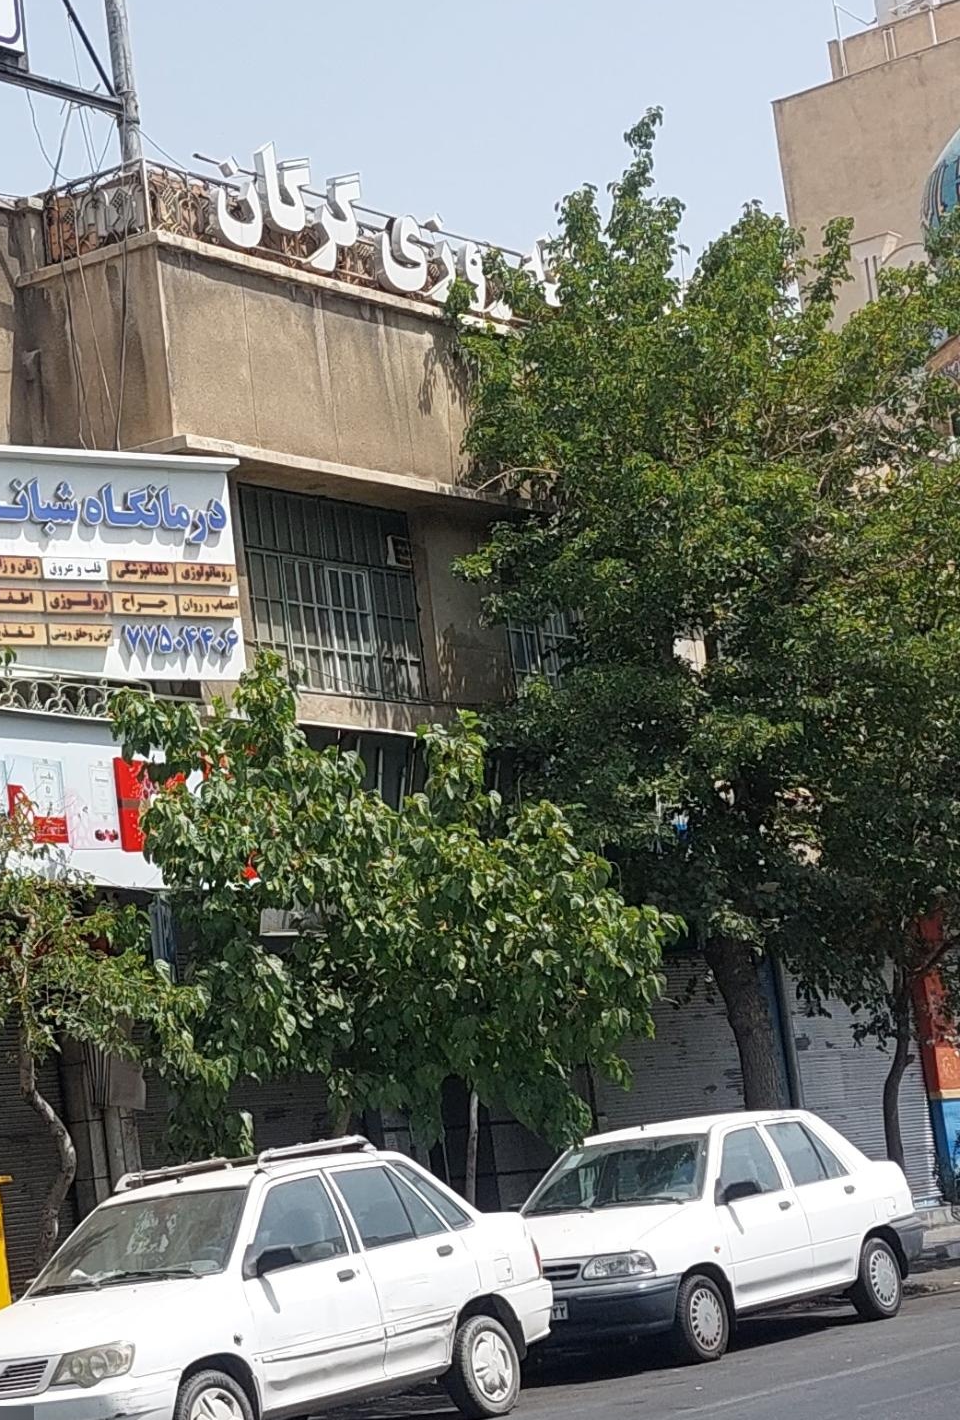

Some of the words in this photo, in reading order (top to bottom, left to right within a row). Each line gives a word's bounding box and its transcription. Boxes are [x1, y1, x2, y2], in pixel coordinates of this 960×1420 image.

[209, 140, 360, 273] گرگان
[82, 482, 227, 545] درمانگاه
[9, 563, 16, 574] و
[17, 558, 38, 575] زنان
[49, 563, 73, 577] عروق
[76, 564, 82, 577] و
[85, 558, 102, 575] قلب
[49, 593, 108, 611] ارولوژی
[121, 594, 168, 612] جراح
[182, 597, 203, 613] روان
[211, 598, 239, 613] اعصاب
[123, 623, 239, 657] ۷۷۵۰۴۴۰۶
